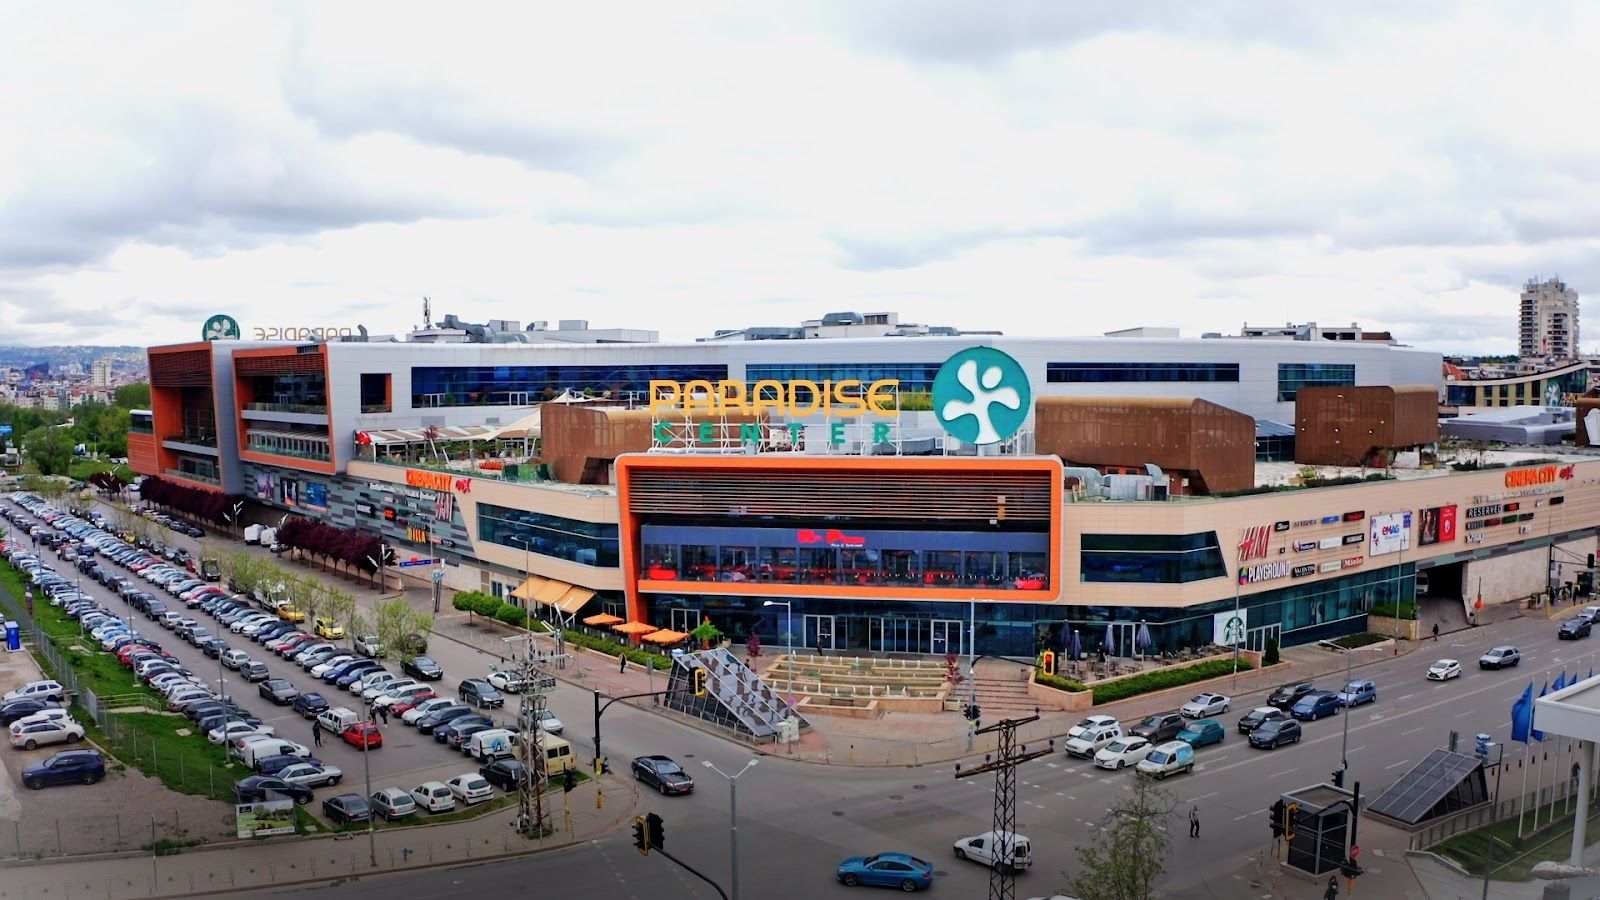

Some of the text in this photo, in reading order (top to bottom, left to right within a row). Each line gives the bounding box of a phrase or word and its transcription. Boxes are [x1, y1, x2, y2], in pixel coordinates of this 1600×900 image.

[649, 379, 899, 416] PARADISE
[655, 421, 891, 444] CENTER
[1505, 470, 1538, 488] CINEMA
[1539, 465, 1557, 484] CITY
[1468, 504, 1503, 518] RESERVED
[1248, 561, 1291, 583] PLAYGROUND
